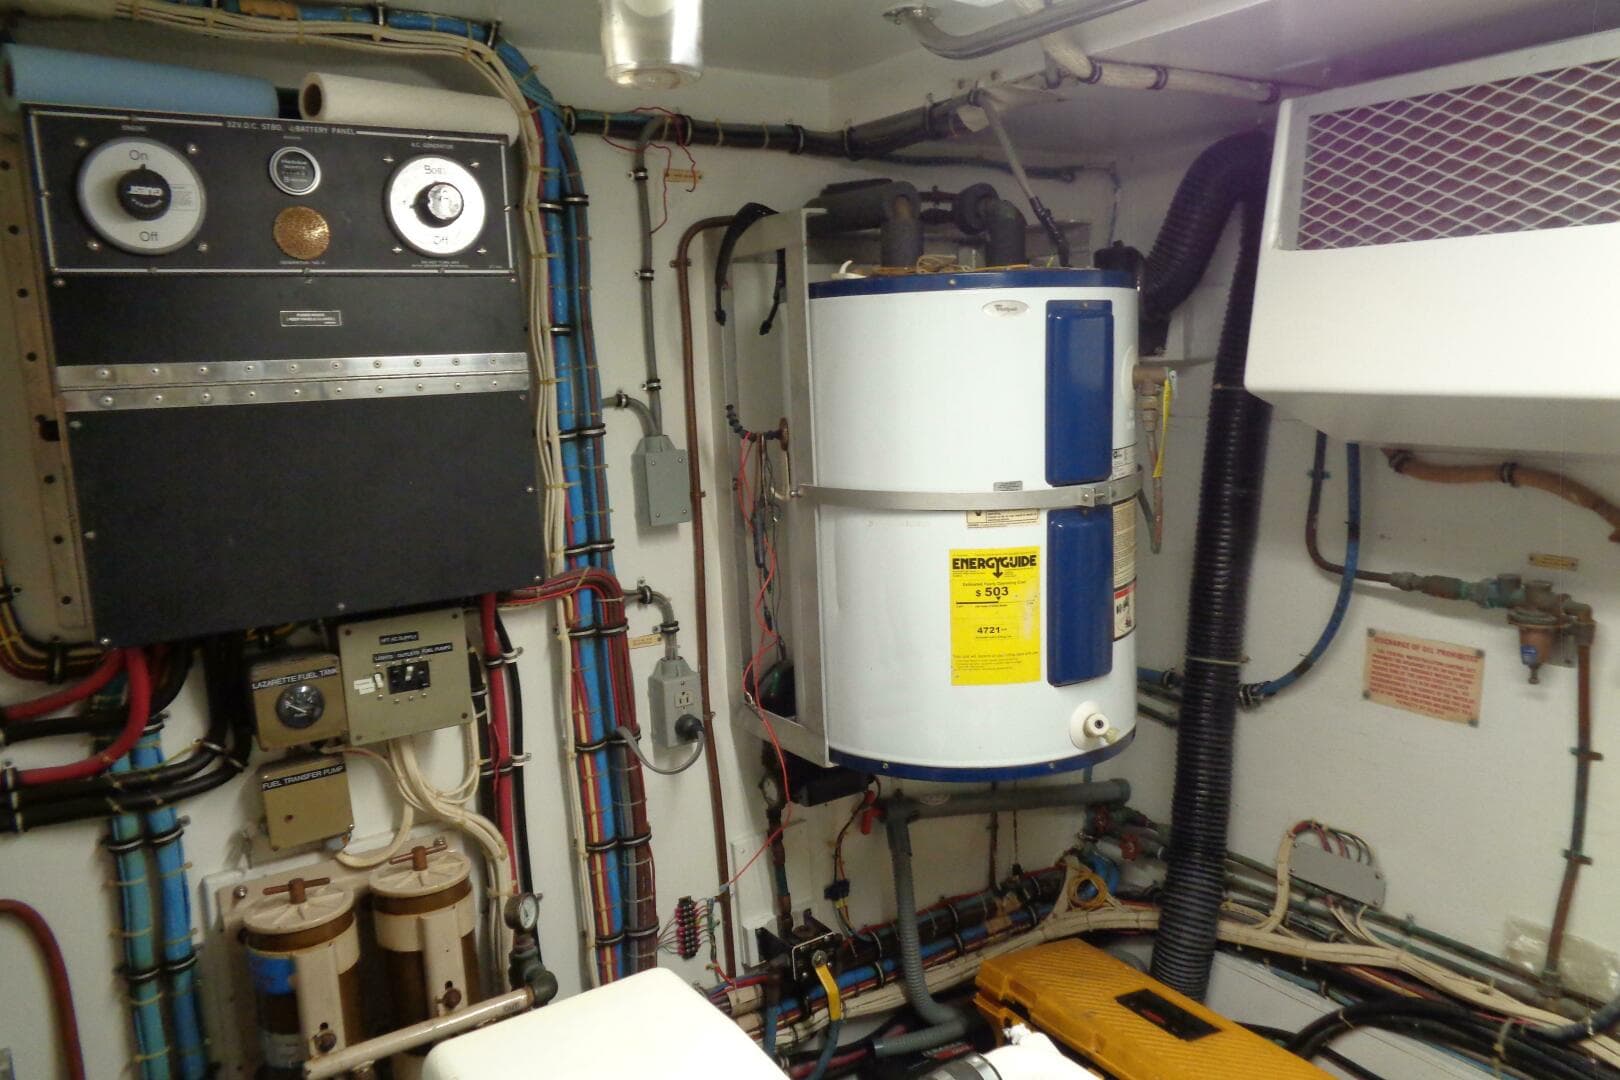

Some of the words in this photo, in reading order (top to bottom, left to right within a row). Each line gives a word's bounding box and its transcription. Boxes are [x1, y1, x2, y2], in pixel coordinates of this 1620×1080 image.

[129, 149, 149, 160] On
[139, 231, 158, 242] Off
[984, 586, 1009, 597] 503
[976, 626, 1001, 634] 4721
[298, 671, 318, 680] FUEL
[320, 668, 338, 677] TANK
[262, 779, 282, 789] FUEL
[283, 770, 322, 784] TRANSFER
[323, 765, 344, 776] PUMP
